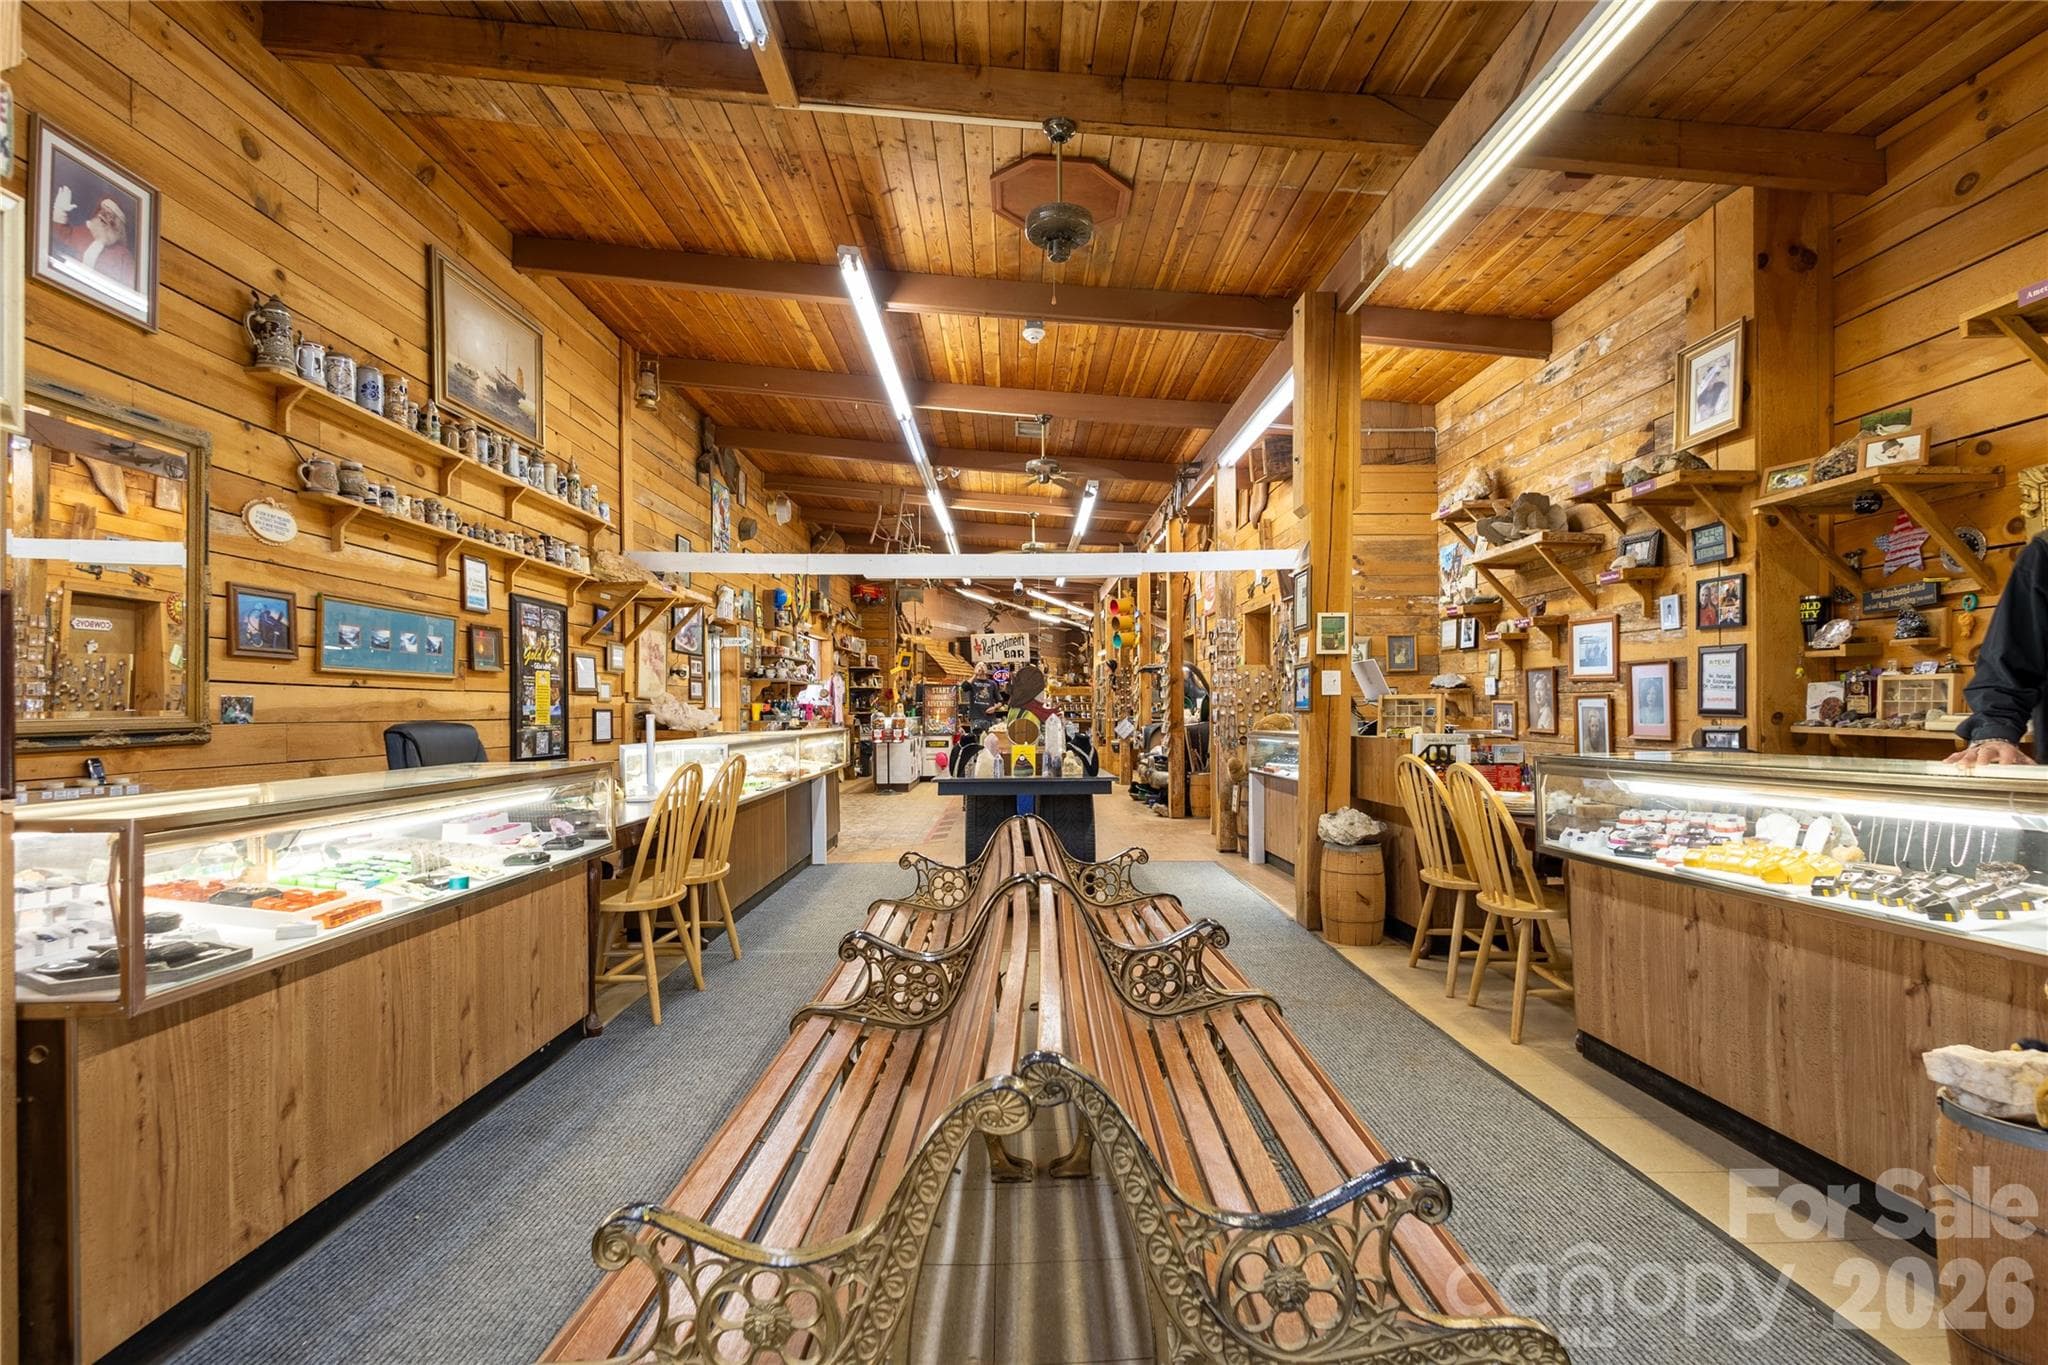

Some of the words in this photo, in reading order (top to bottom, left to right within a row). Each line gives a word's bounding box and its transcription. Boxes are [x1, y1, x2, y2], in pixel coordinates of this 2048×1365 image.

[981, 635, 1025, 659] Refreshment
[1004, 649, 1025, 659] BAR
[993, 671, 1010, 680] OPEN
